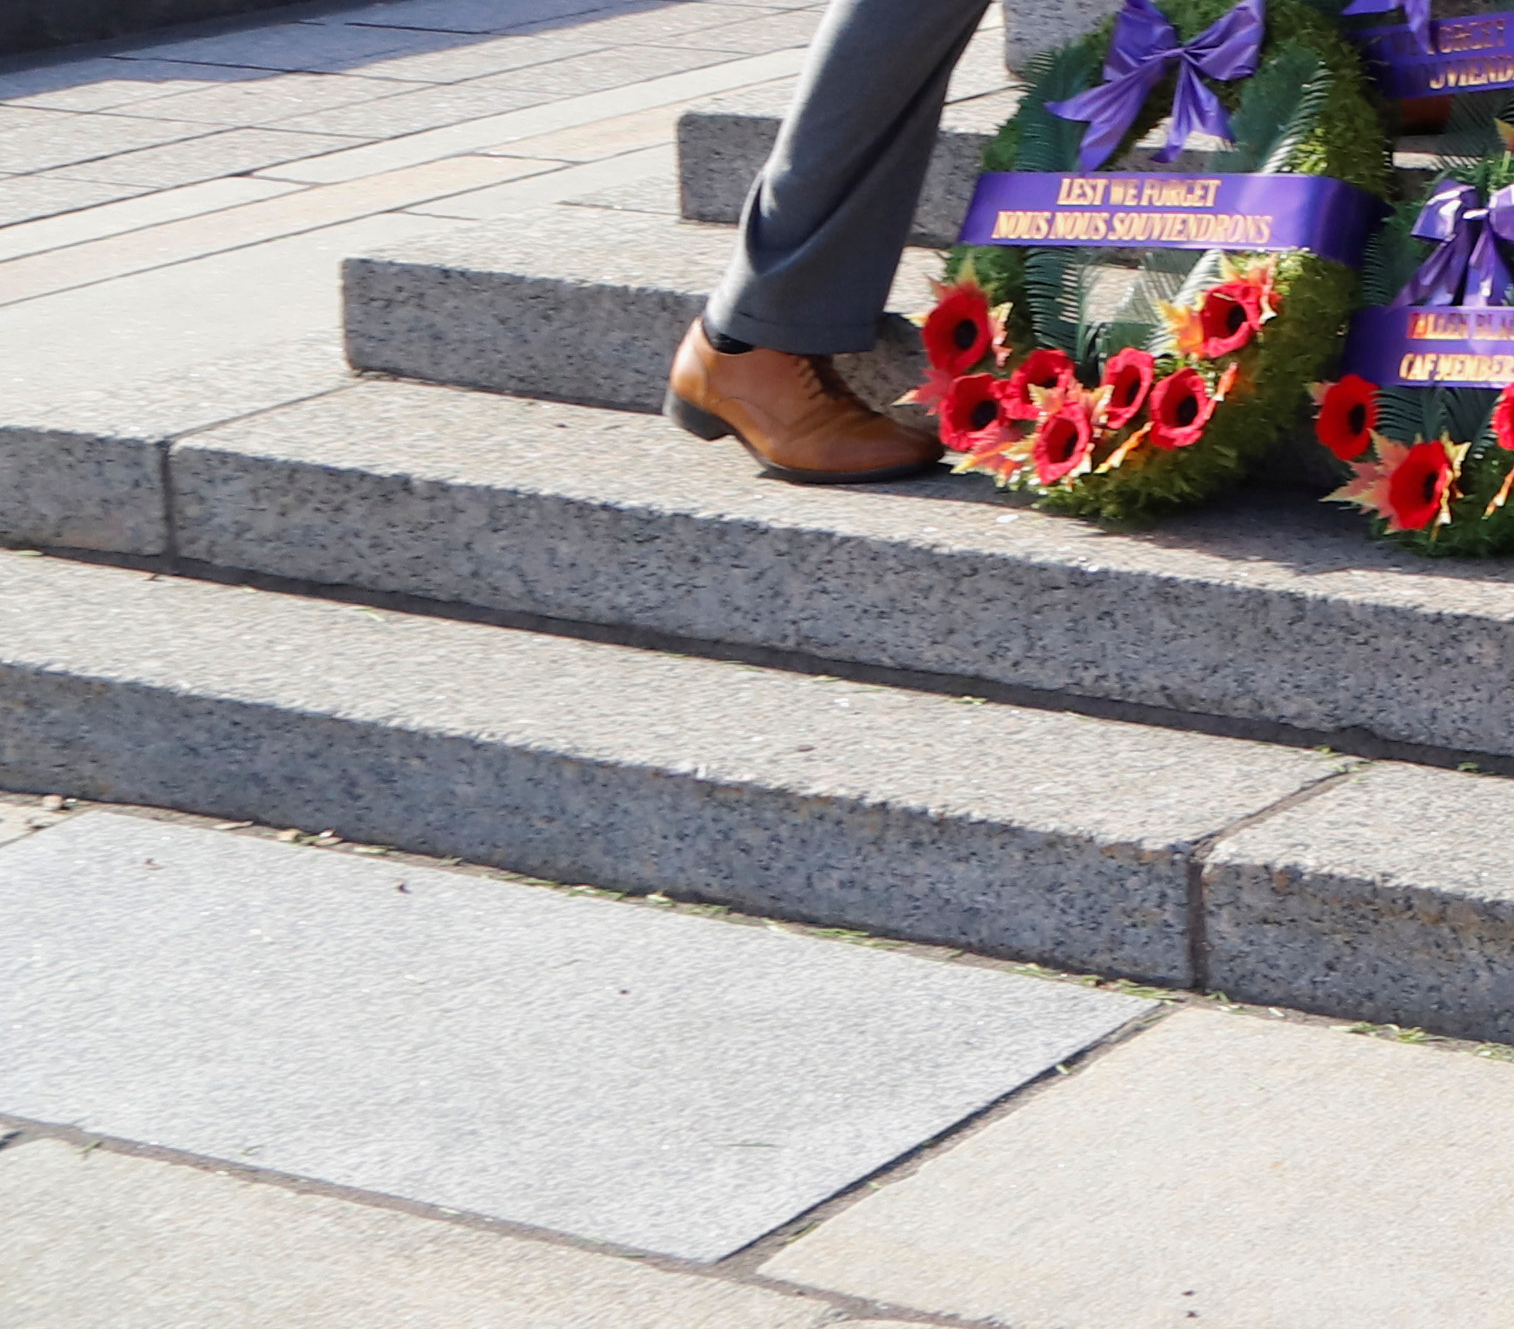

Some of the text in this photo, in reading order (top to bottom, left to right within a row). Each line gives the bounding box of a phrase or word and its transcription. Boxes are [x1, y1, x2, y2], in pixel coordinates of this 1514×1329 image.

[1056, 178, 1223, 208] LEST WE FORGET
[991, 211, 1275, 244] NOUS NOUS SOUVIENDRONS
[1399, 353, 1436, 381] CAF
